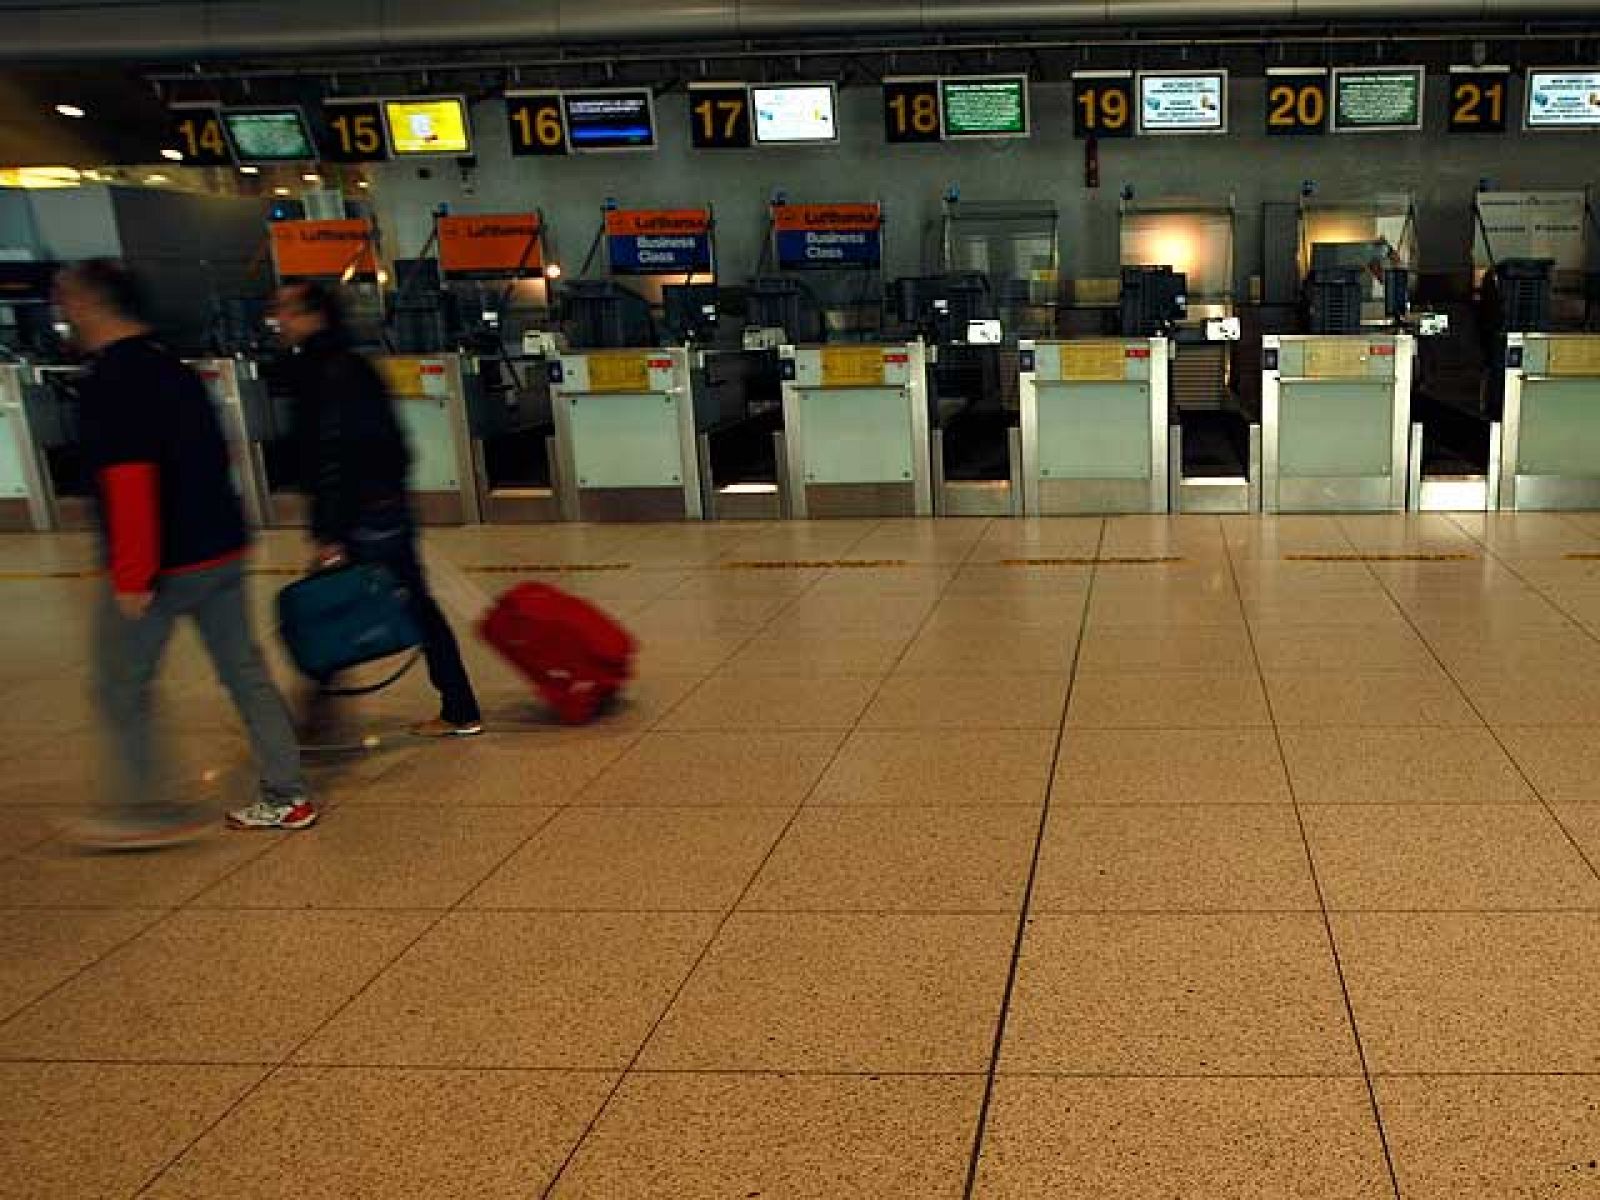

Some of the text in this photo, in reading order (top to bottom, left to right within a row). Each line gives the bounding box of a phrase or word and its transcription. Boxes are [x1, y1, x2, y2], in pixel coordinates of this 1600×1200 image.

[696, 100, 742, 139] 17
[889, 94, 939, 135] 18
[1079, 89, 1128, 129] 19
[1269, 85, 1325, 126] 20
[1454, 84, 1502, 124] 21
[179, 119, 225, 156] 14
[332, 114, 380, 153] 15
[513, 106, 561, 146] 16
